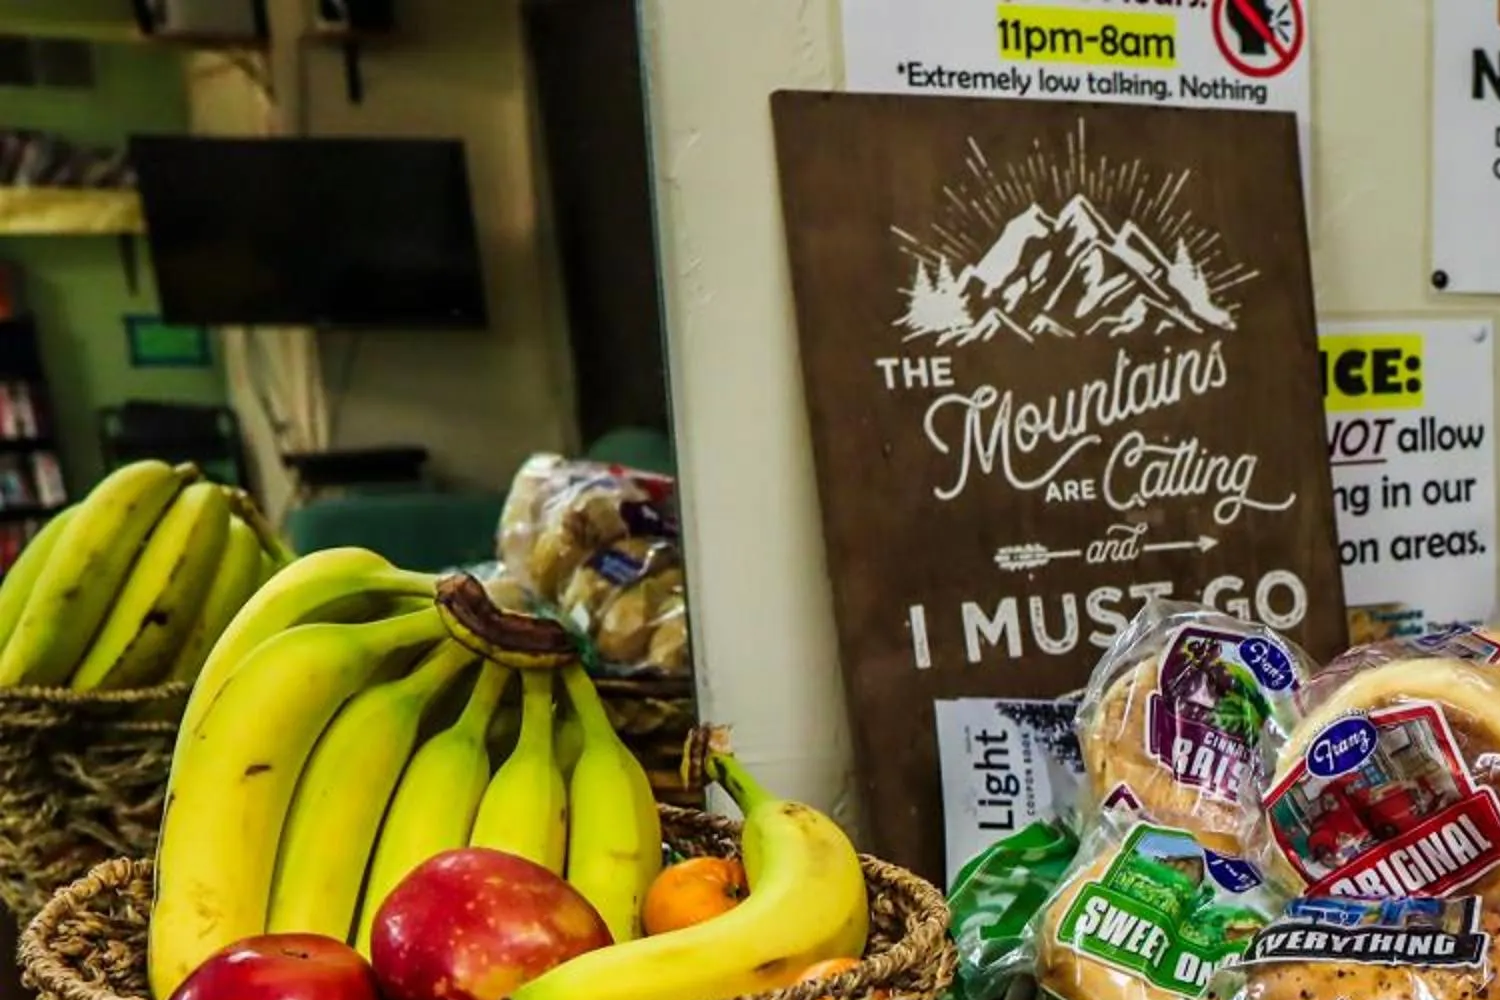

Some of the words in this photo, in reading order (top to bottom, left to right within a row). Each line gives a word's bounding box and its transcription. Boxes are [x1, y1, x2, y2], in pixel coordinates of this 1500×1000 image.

[997, 20, 1175, 60] 11pm-8am
[1039, 70, 1080, 95] low
[1086, 74, 1172, 102] talking.
[1180, 78, 1267, 104] Nothing
[876, 357, 955, 389] THE
[924, 340, 1228, 500] Mountains
[1397, 417, 1485, 452] allow
[1045, 479, 1097, 503] ARE
[1104, 430, 1297, 524] Calling
[1381, 476, 1412, 508] in
[1422, 478, 1476, 505] our
[1086, 522, 1148, 562] and
[1390, 530, 1487, 561] areas.
[909, 604, 932, 669] I
[1201, 570, 1309, 630] GO
[1172, 737, 1249, 797] RAIS
[1313, 728, 1371, 770] Franz
[974, 729, 1021, 831] Light
[1328, 813, 1493, 897] ORIGINAL
[1075, 895, 1171, 968] SWEET
